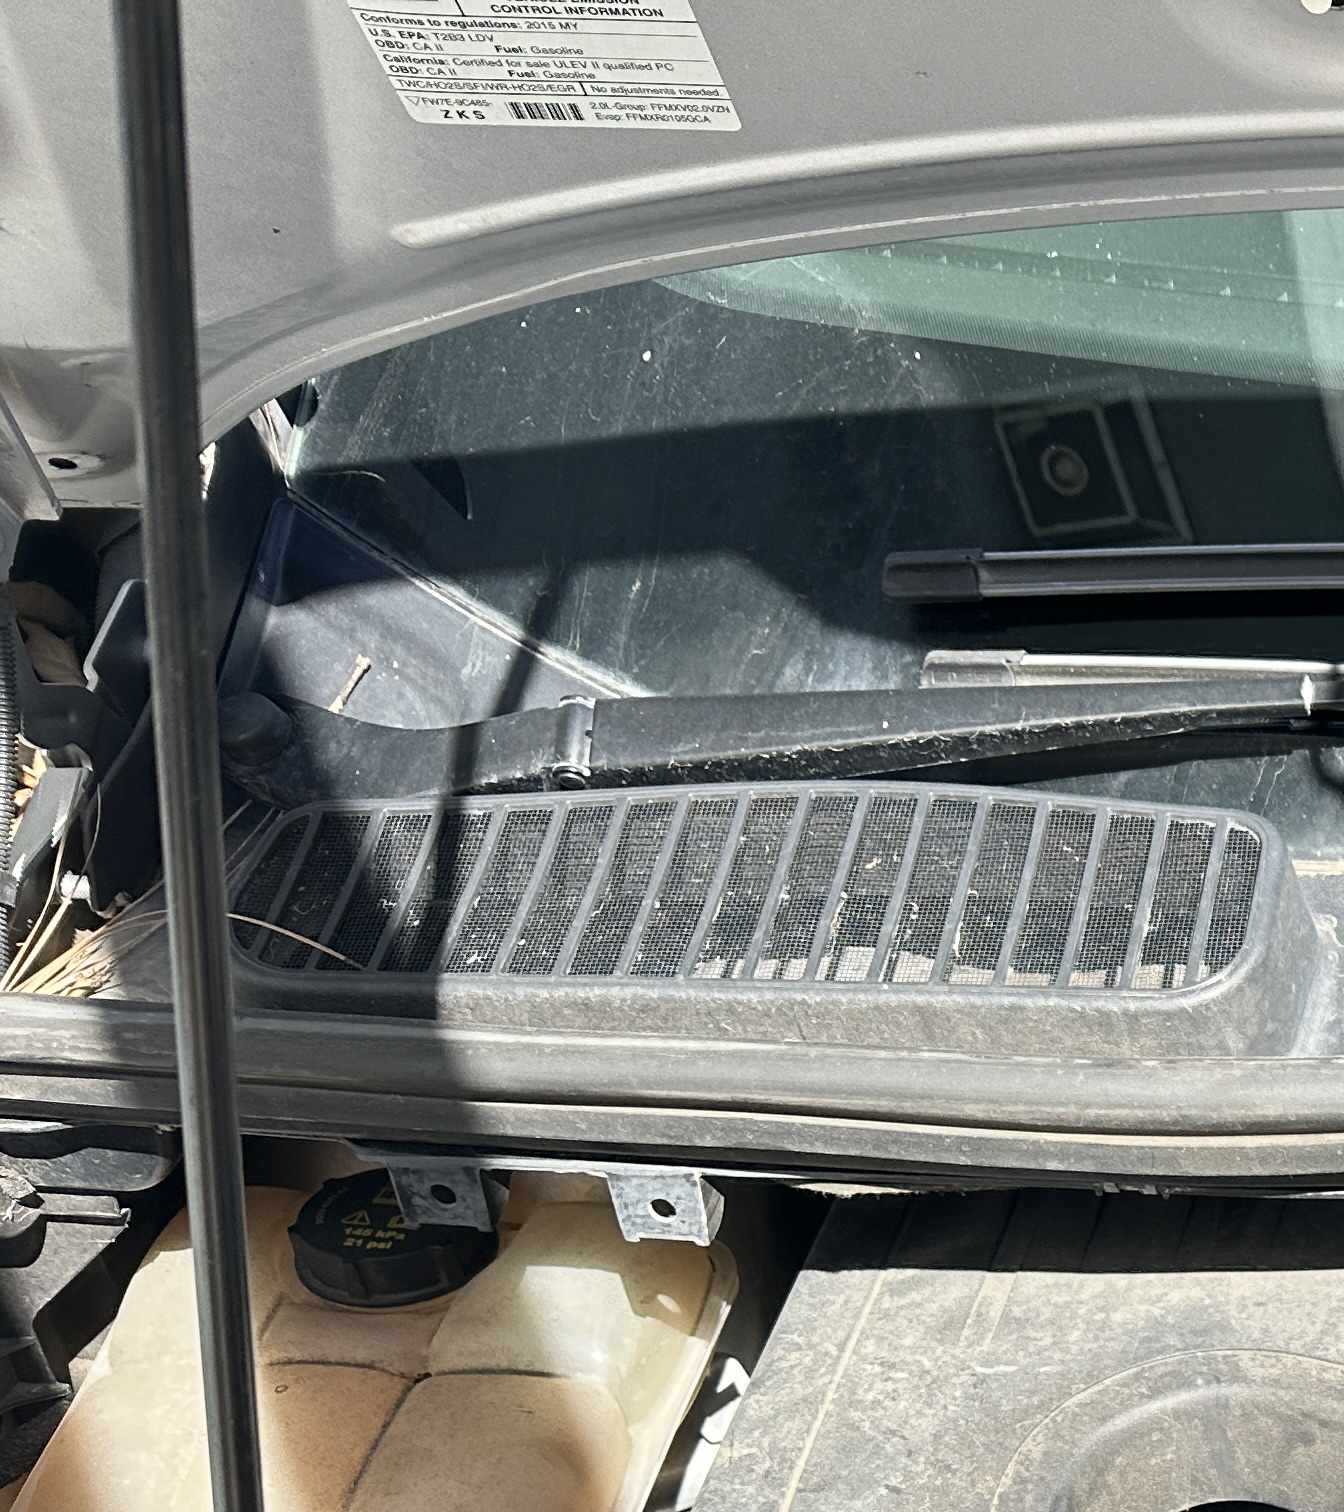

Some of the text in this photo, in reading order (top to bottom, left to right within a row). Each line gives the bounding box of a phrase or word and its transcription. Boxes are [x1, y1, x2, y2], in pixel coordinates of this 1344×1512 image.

[490, 4, 664, 17] CONTROL INFORMATION
[360, 12, 578, 30] Conforms to regulations: 2015 MY
[400, 30, 430, 40] EPA:
[469, 34, 494, 42] LDV
[375, 39, 409, 49] OBD:
[413, 41, 432, 51] CA
[494, 44, 584, 55] Fuel: Gasoline
[382, 53, 449, 65] California:
[452, 57, 502, 68] Certified
[505, 58, 522, 68] for
[526, 59, 550, 69] sale
[552, 60, 587, 69] ULEV
[603, 61, 652, 71] qualified
[655, 63, 674, 71] PC
[426, 67, 446, 76] CA
[507, 69, 596, 80] Fuel: Gasoline
[591, 85, 607, 93] No
[610, 85, 676, 96] adjustments
[375, 1230, 406, 1240] kPa
[343, 1237, 393, 1250] 21 psi
